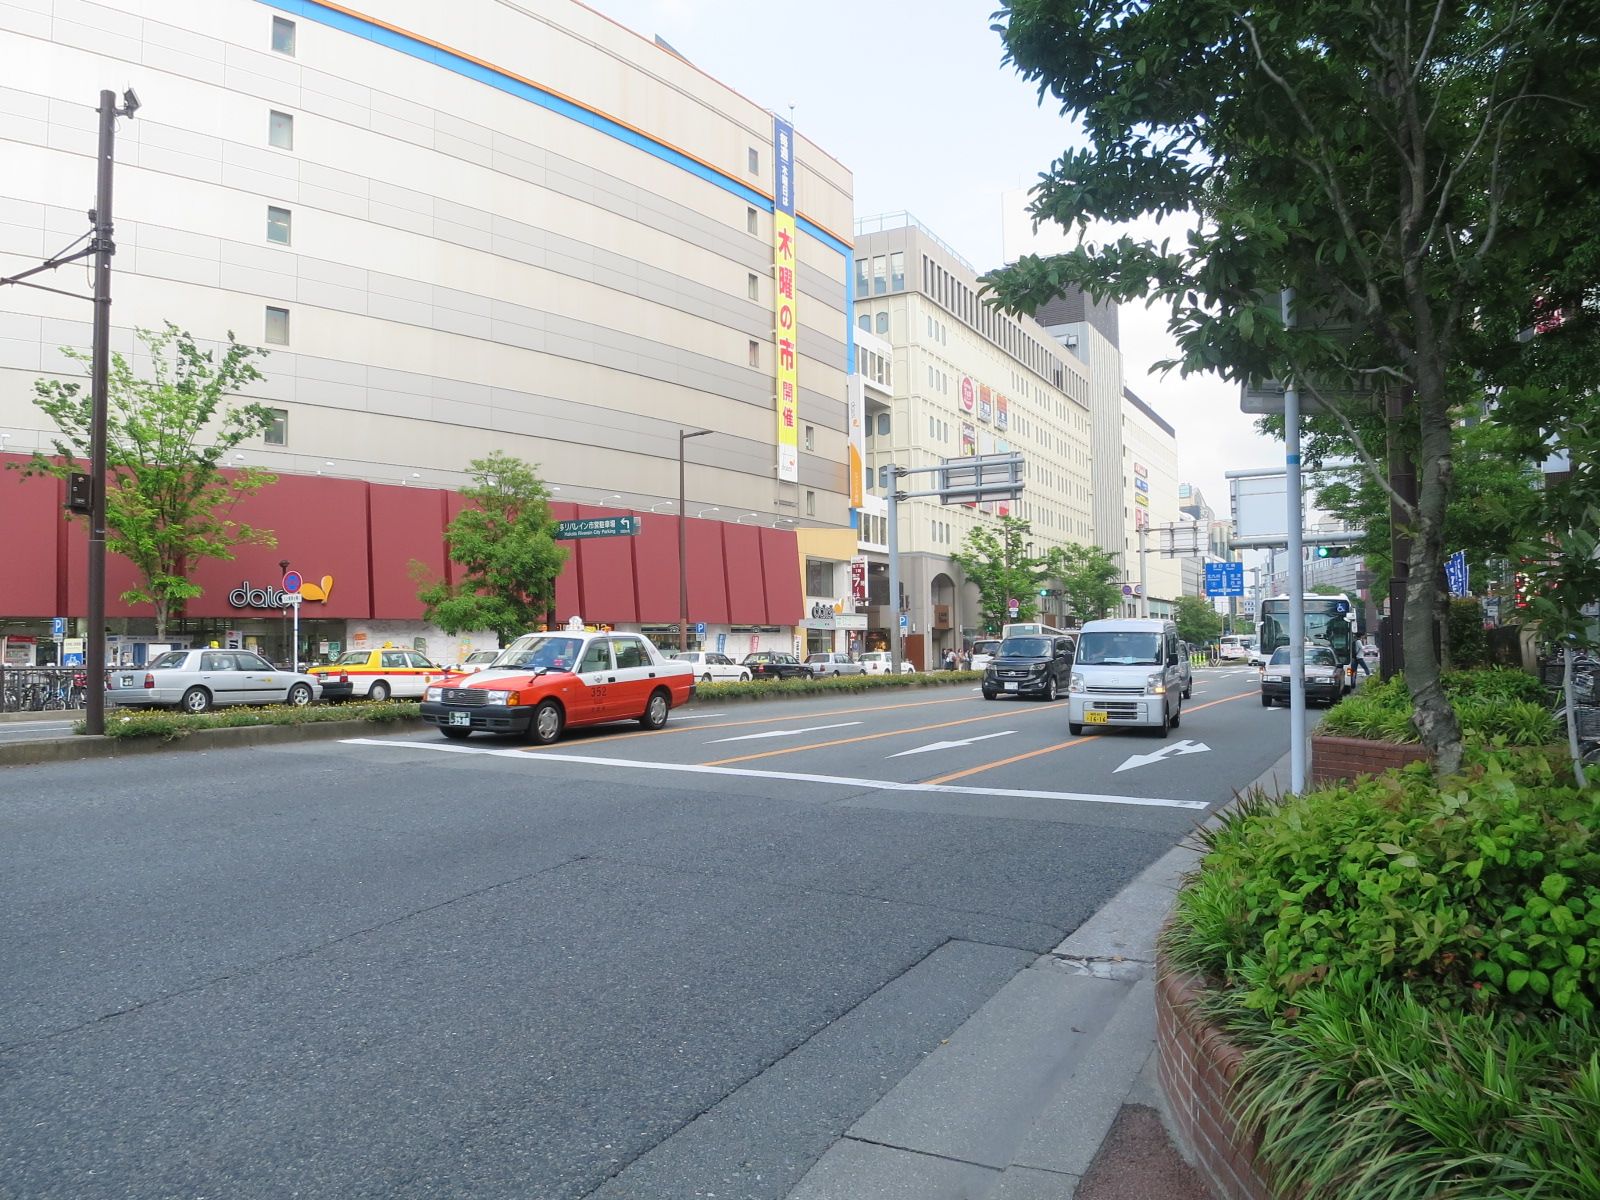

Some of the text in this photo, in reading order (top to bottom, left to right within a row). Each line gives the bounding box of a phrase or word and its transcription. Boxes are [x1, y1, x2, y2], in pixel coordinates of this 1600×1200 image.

[778, 228, 793, 371] 木曜の市
[55, 620, 61, 632] P
[698, 624, 703, 632] P
[591, 686, 607, 697] 352
